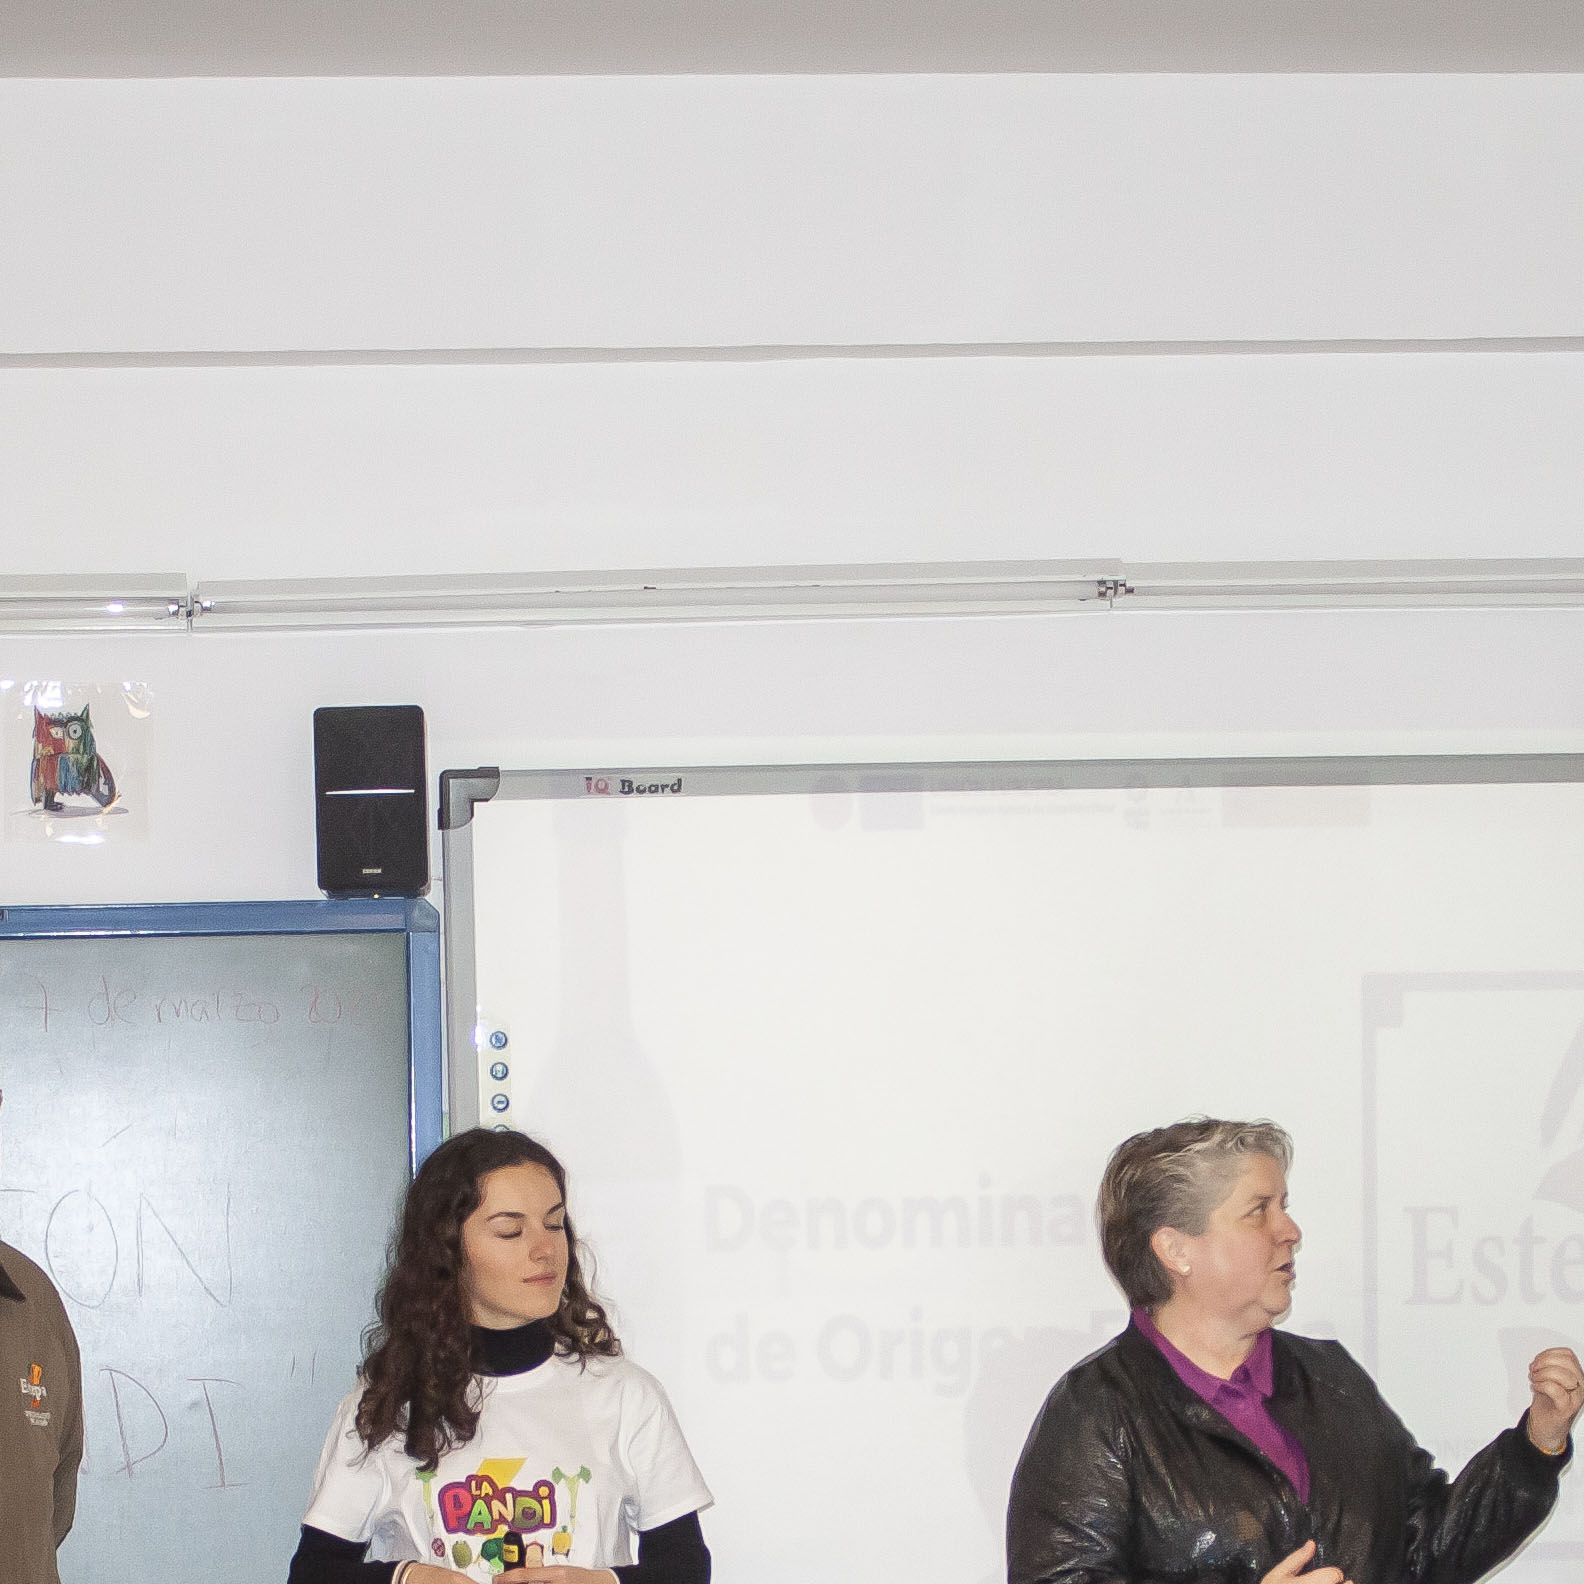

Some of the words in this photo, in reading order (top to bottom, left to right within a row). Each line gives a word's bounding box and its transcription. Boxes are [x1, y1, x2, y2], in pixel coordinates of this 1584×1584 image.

[619, 776, 683, 796] Board
[88, 975, 138, 1028] de
[704, 1171, 1088, 1253] Denomina
[470, 1479, 494, 1498] LA
